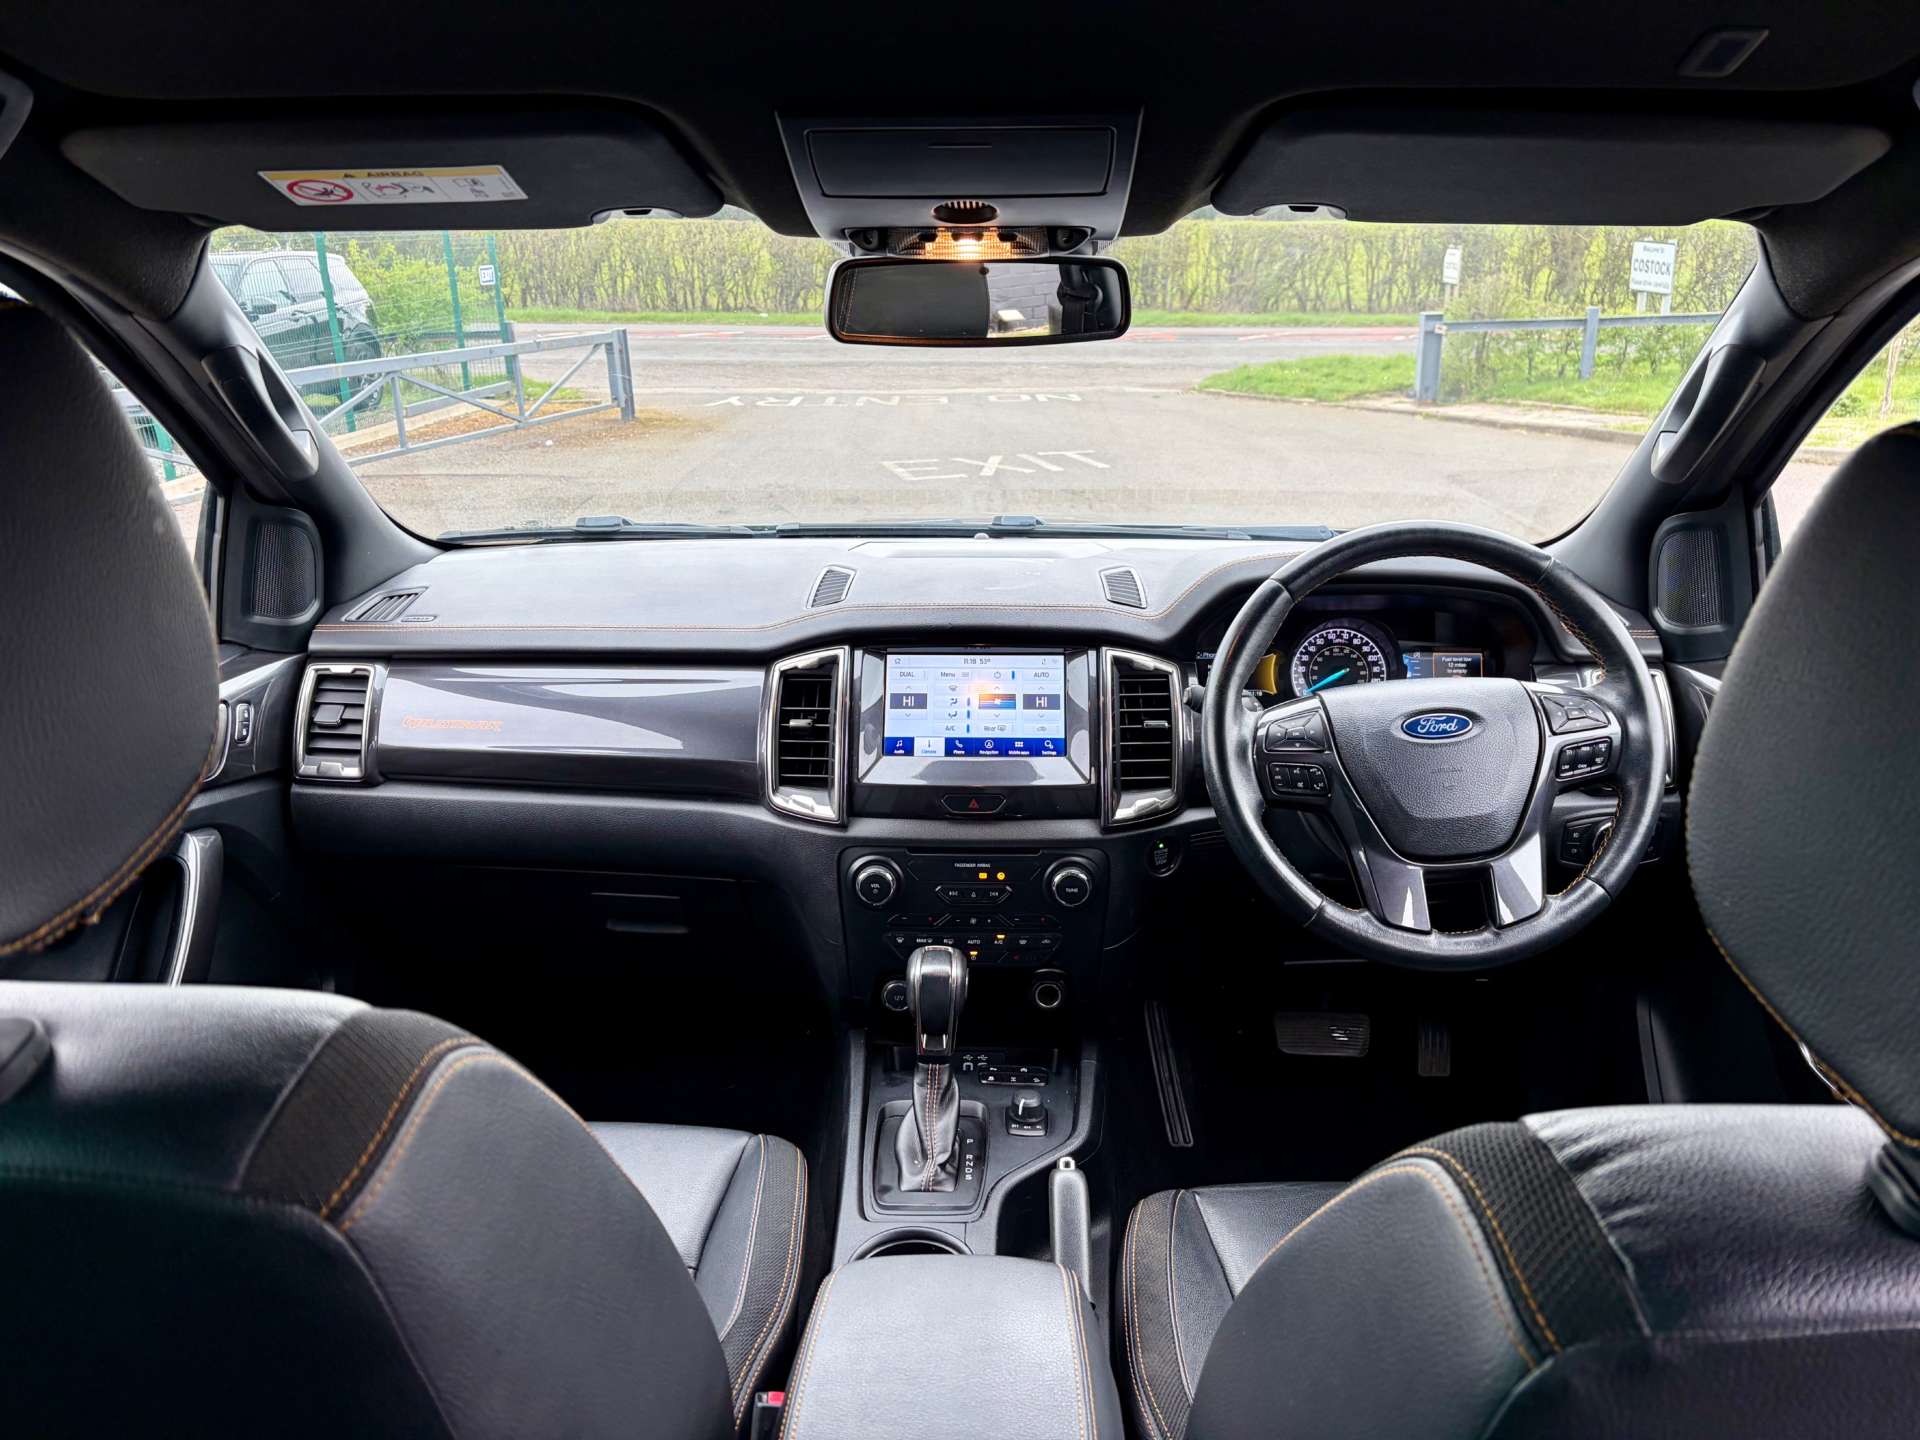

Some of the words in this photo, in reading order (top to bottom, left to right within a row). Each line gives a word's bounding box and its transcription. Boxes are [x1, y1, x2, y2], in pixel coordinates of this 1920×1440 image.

[1633, 258, 1671, 276] COSTOCK
[880, 449, 1111, 481] EXIT
[902, 696, 915, 707] HI
[1035, 696, 1048, 707] HI
[1417, 717, 1458, 733] Ford
[965, 1160, 974, 1168] N
